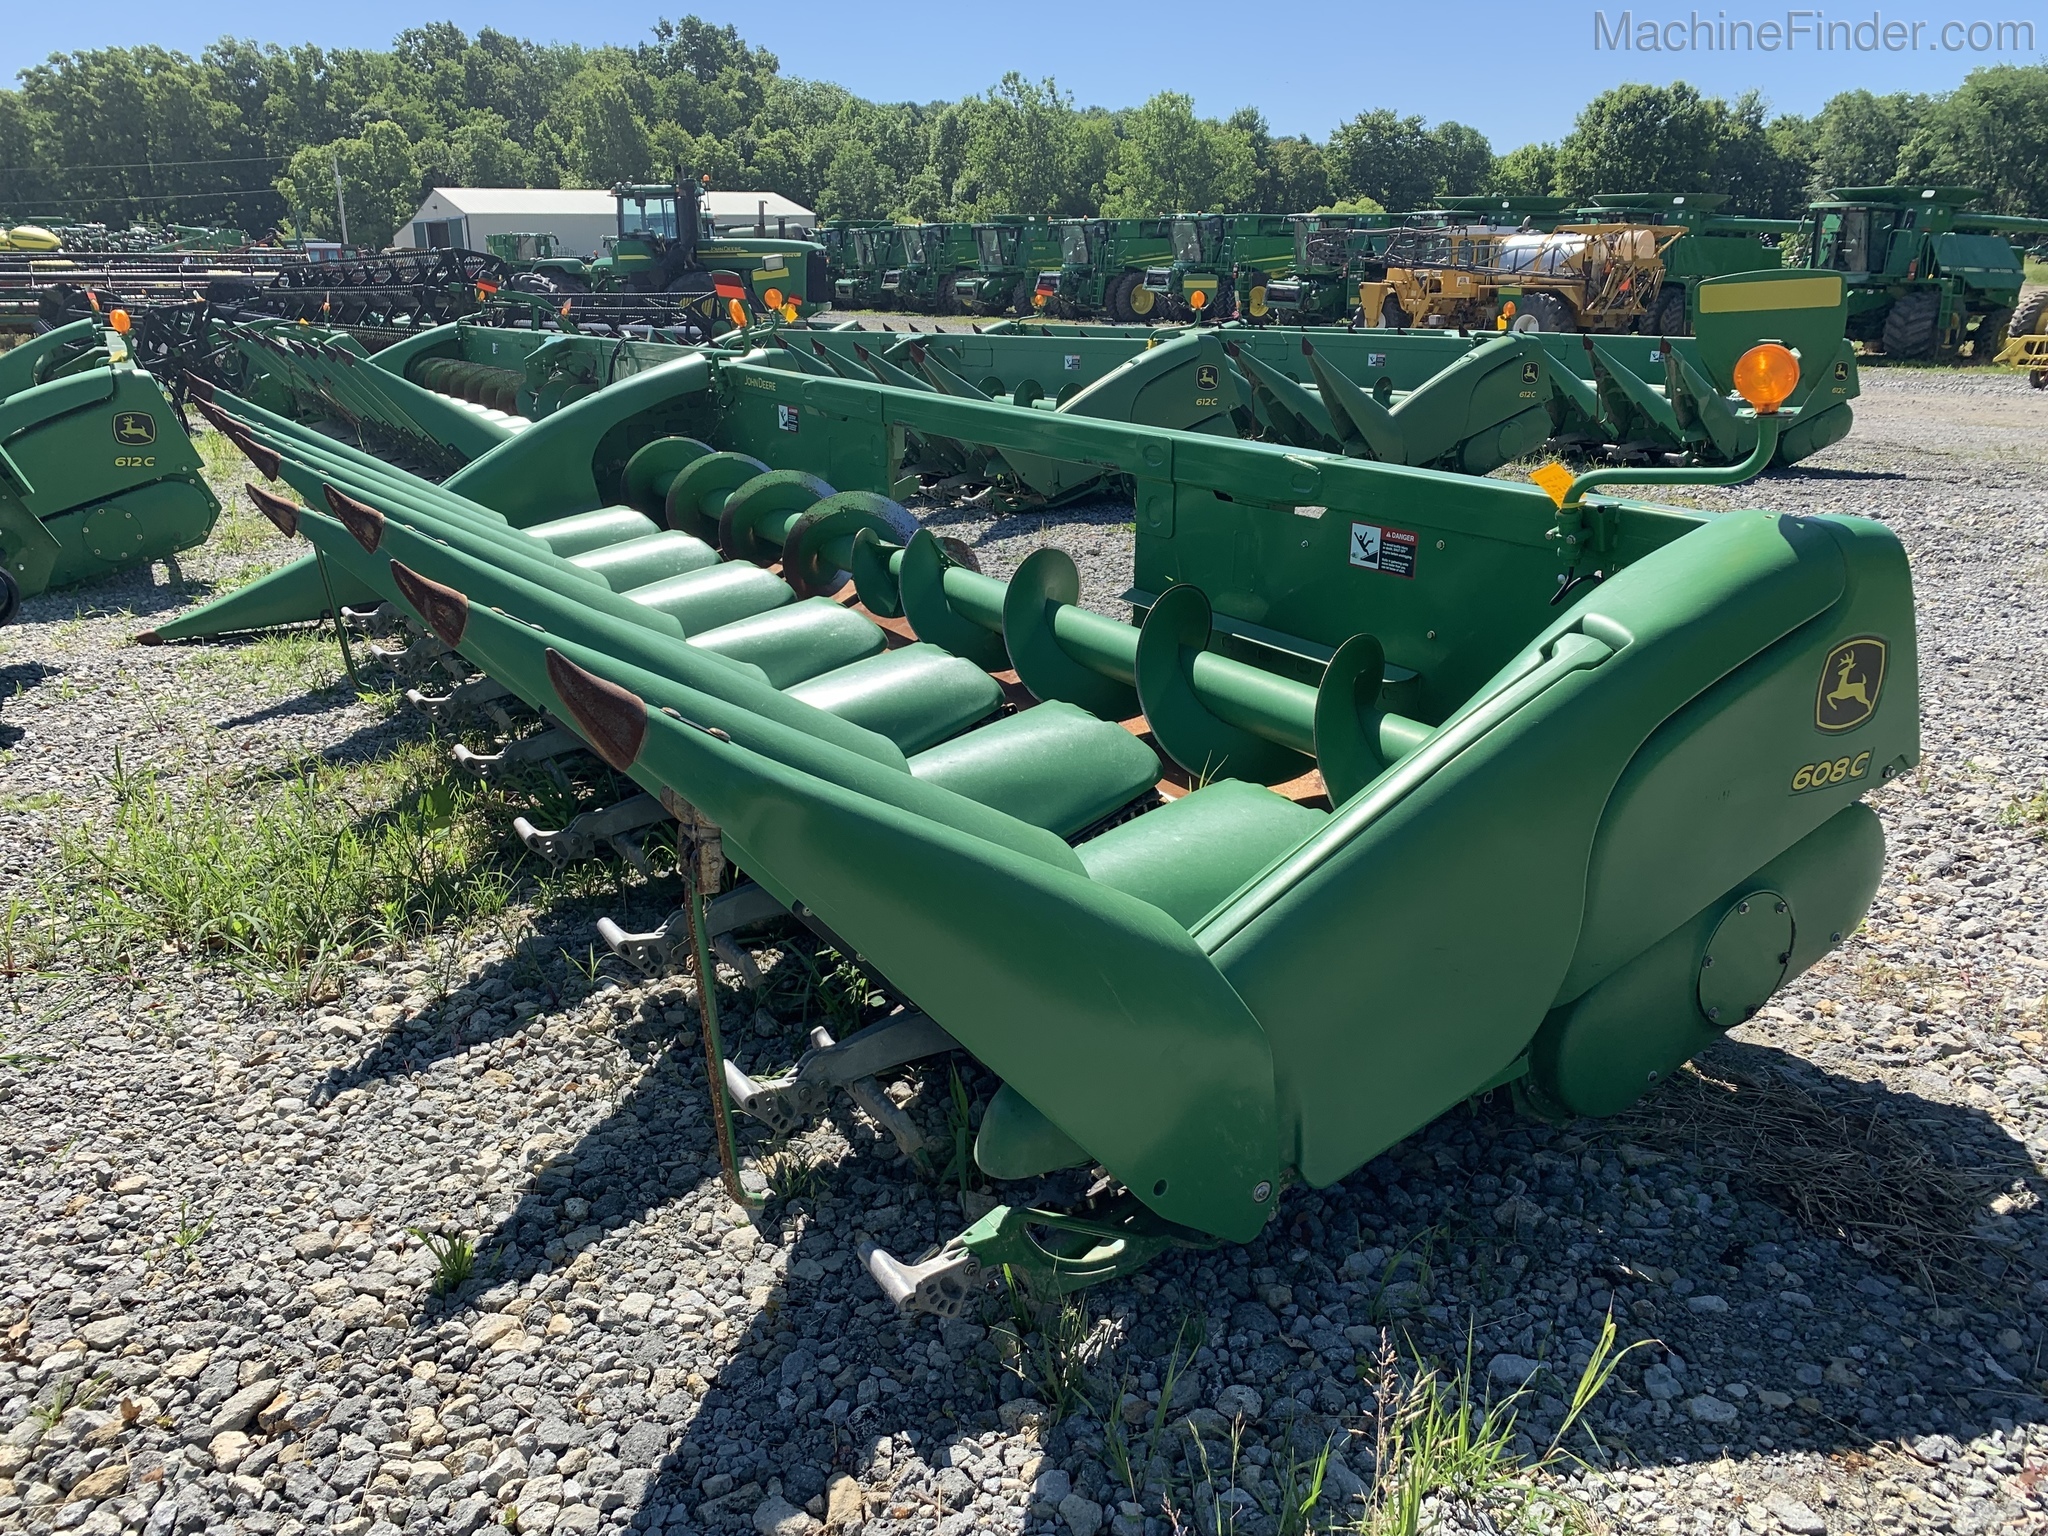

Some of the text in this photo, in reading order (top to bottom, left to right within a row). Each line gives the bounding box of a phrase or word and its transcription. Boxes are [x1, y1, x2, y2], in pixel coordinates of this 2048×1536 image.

[1195, 397, 1218, 406] 612C
[114, 456, 156, 467] 612C
[1391, 531, 1415, 542] DANGER
[1790, 750, 1871, 792] 608C
